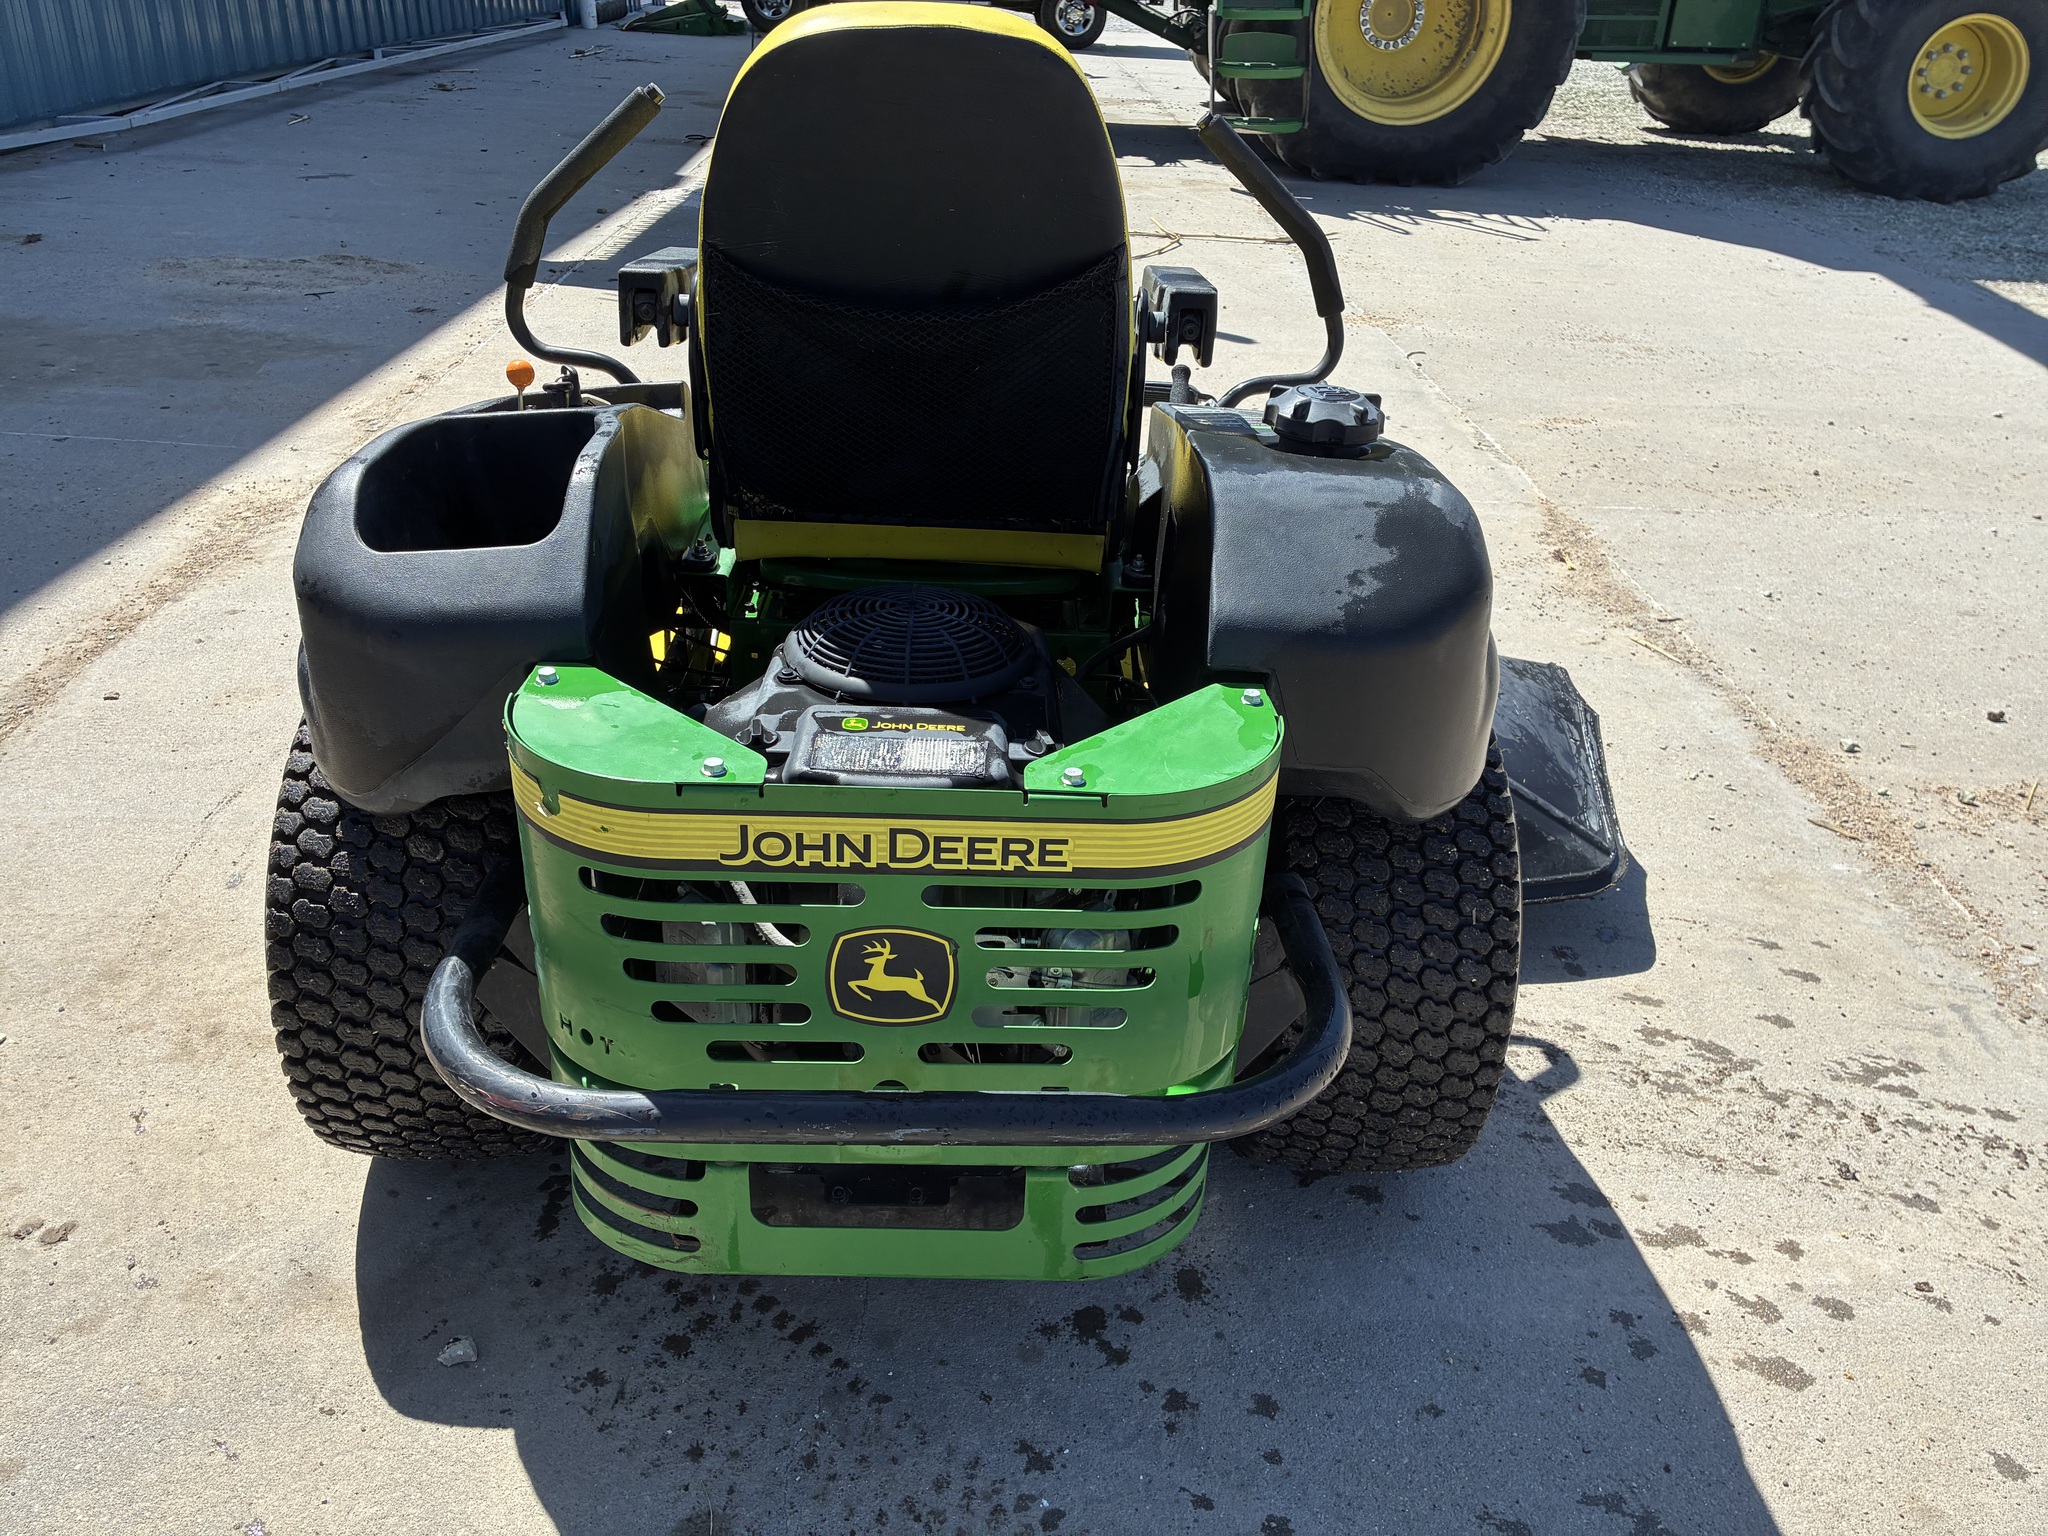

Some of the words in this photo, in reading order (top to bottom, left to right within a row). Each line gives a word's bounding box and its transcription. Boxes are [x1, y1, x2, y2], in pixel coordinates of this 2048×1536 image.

[871, 721, 913, 730] JOHN
[916, 723, 966, 732] DEERE
[719, 824, 873, 864] JOHN
[888, 827, 1070, 869] DEERE
[559, 1012, 614, 1055] HOT
